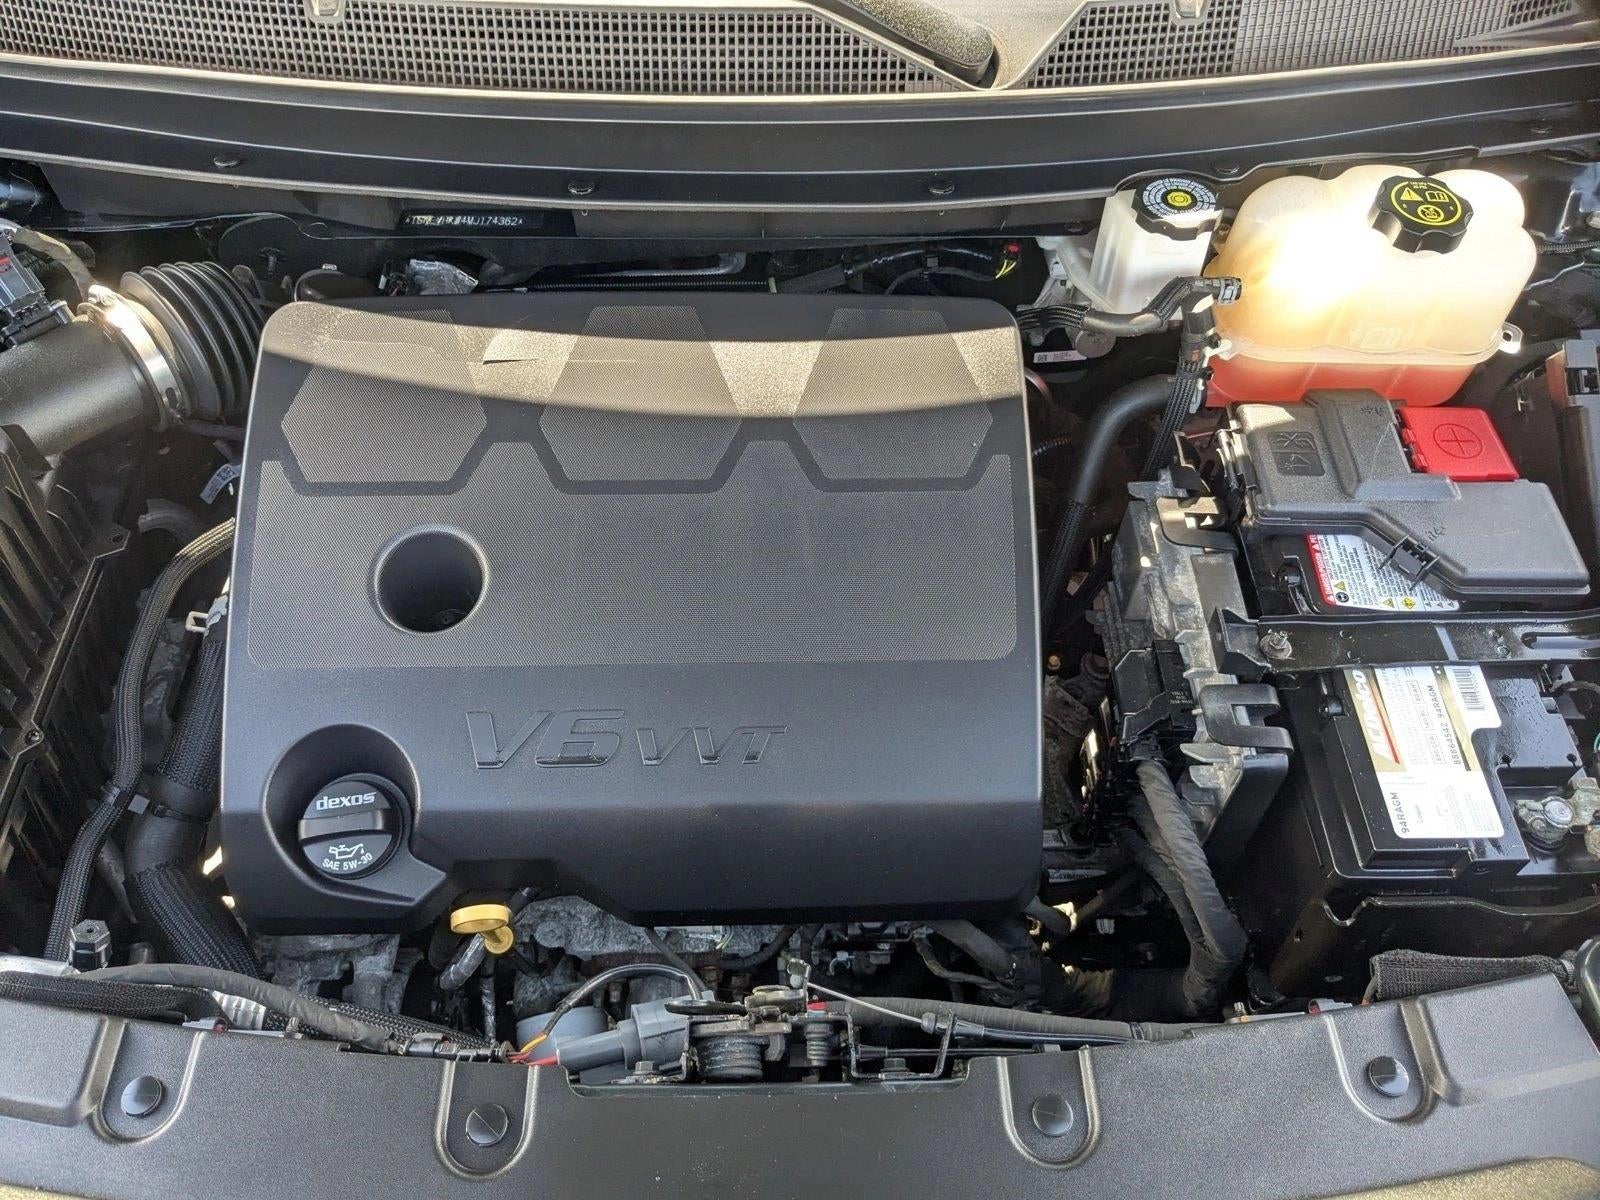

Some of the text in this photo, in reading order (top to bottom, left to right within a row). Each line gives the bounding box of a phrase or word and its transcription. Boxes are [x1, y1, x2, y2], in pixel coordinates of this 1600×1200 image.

[1426, 685, 1445, 719] 94RAGM
[465, 709, 788, 769] V6 VVT
[316, 791, 377, 811] dexos
[1389, 791, 1410, 834] 94RAGM
[322, 852, 373, 871] SAE 5W-30
